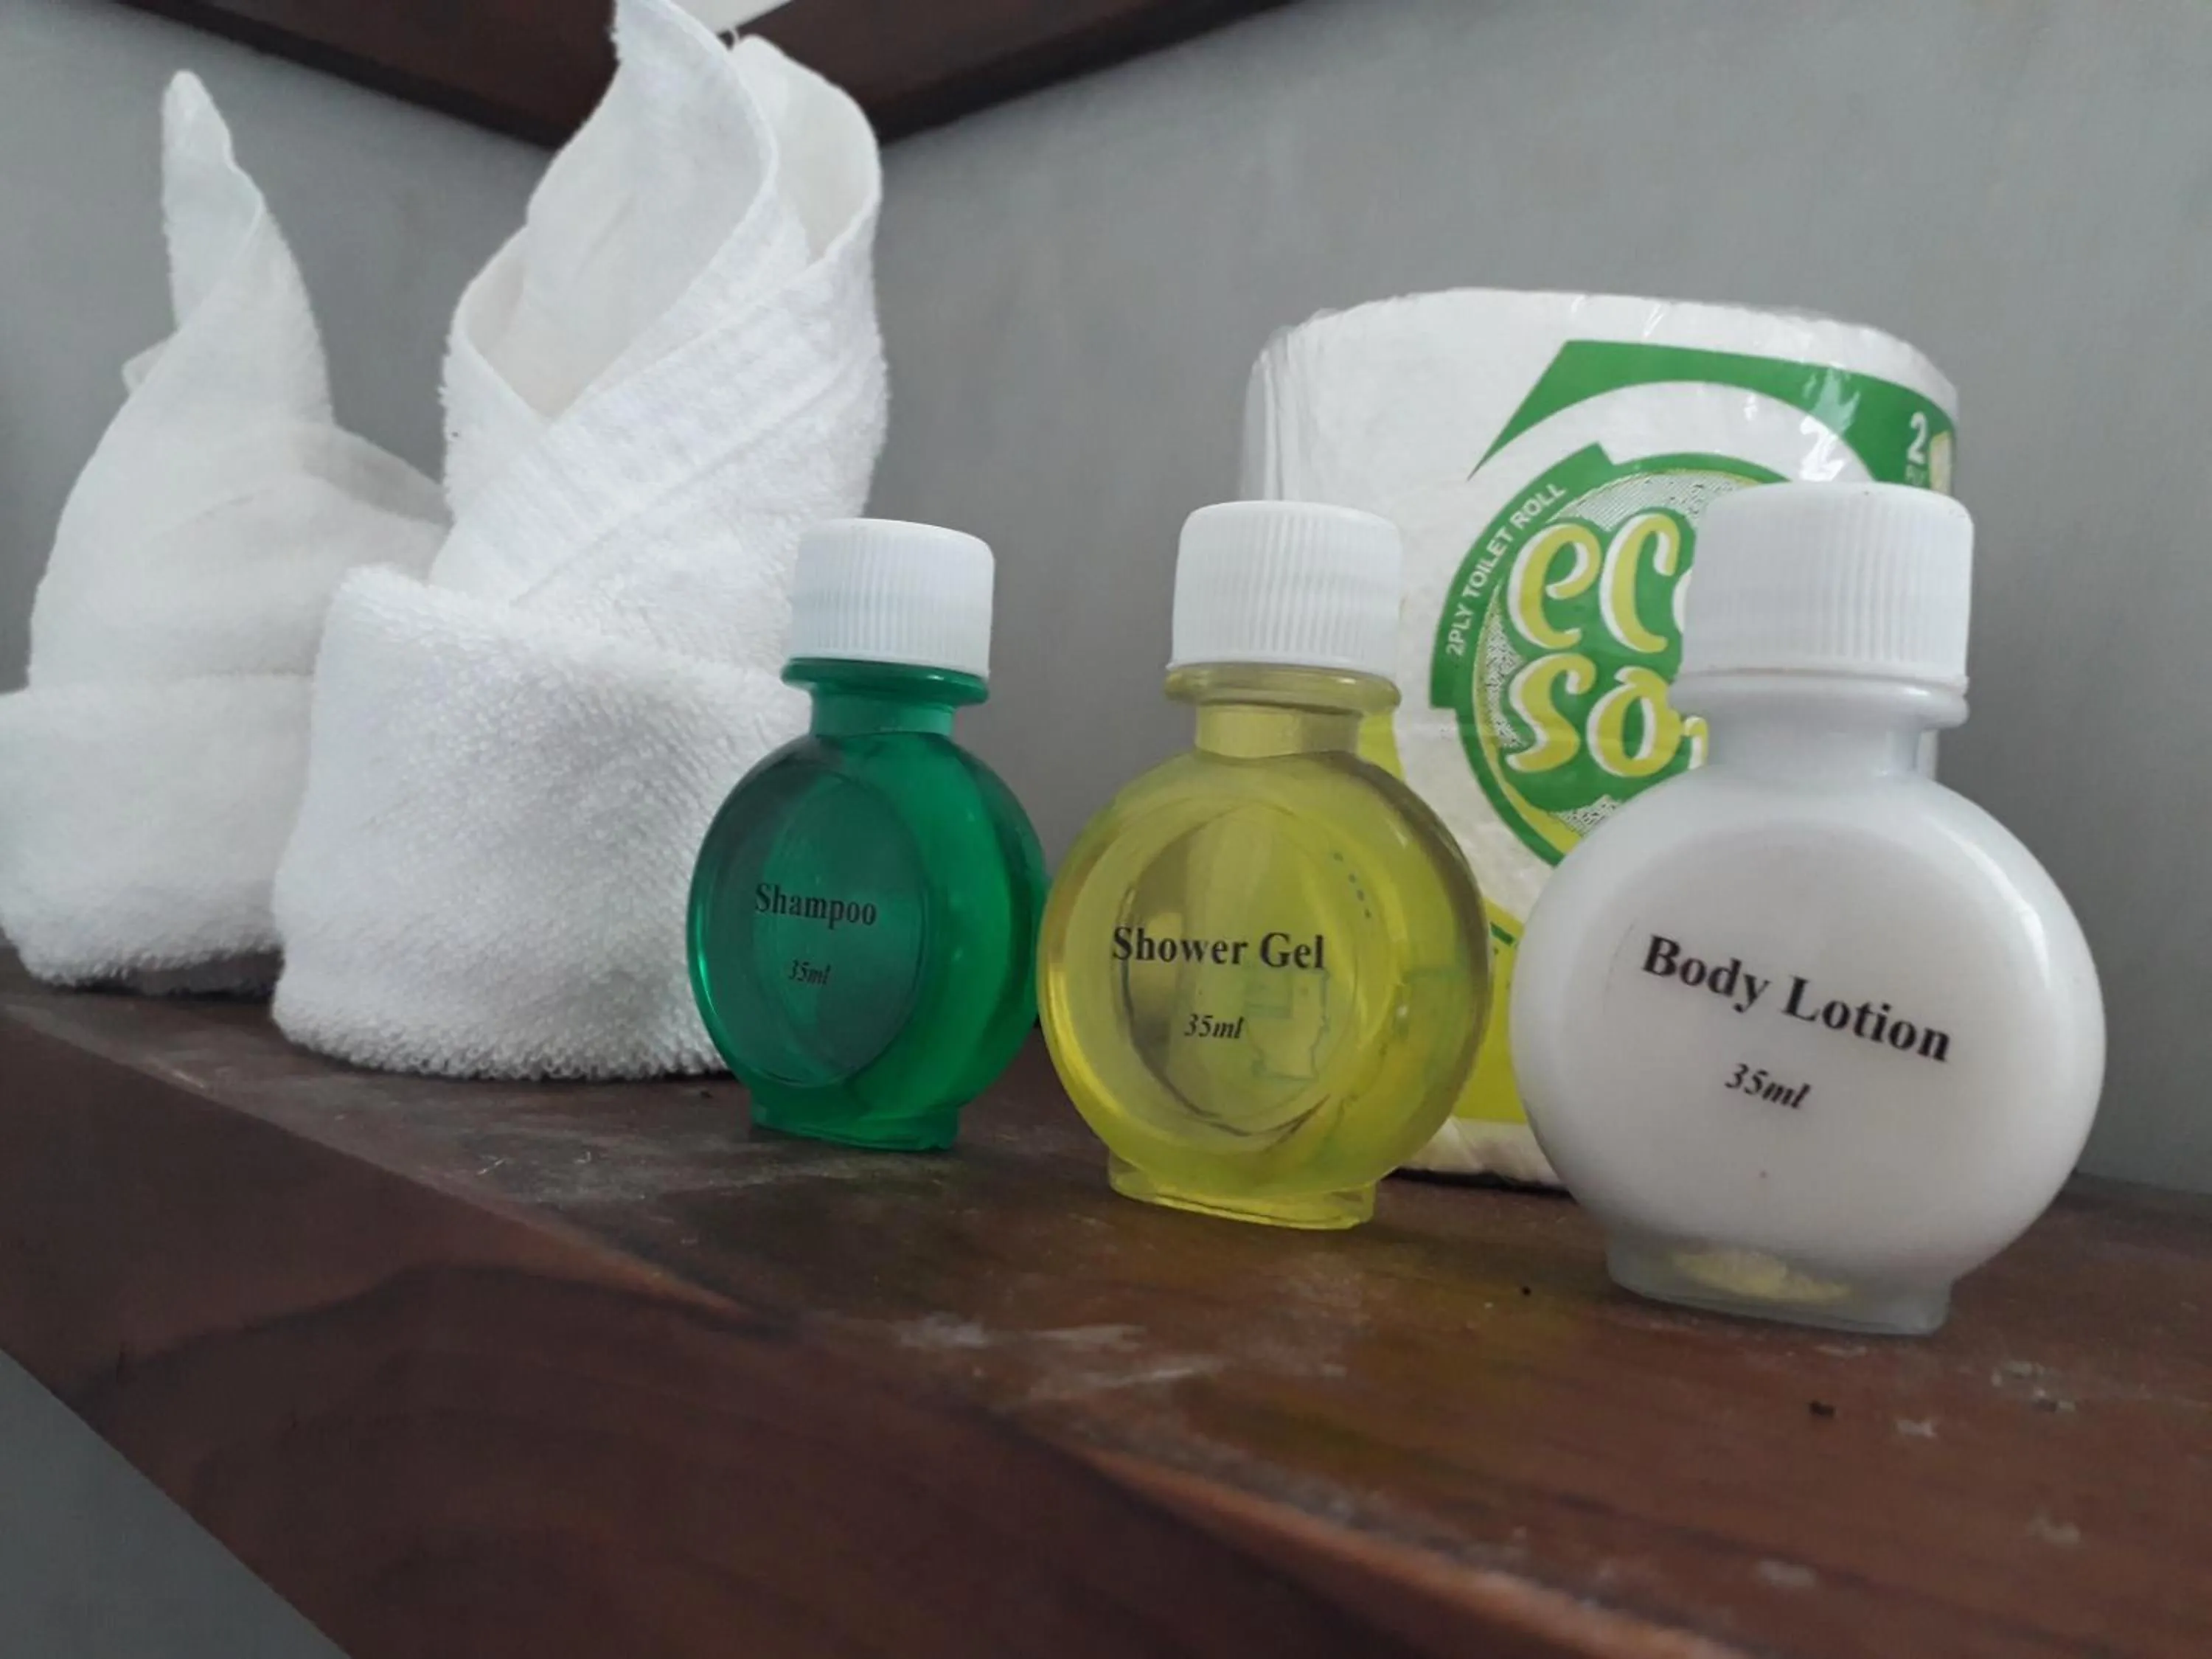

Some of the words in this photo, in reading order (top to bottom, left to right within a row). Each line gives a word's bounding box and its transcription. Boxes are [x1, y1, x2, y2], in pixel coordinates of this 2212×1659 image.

[1446, 602, 1474, 656] 2PLY
[1462, 525, 1514, 599] TOILET
[1509, 483, 1568, 530] ROLL
[754, 883, 877, 931] Shampoo
[788, 959, 832, 986] 35ml
[1111, 927, 1249, 966] Shower
[1259, 932, 1326, 970] Gel
[1641, 933, 1771, 1013] Body
[1781, 975, 1952, 1062] Lotion
[1183, 1013, 1245, 1040] 35ml
[1724, 1062, 1812, 1110] 35ml
